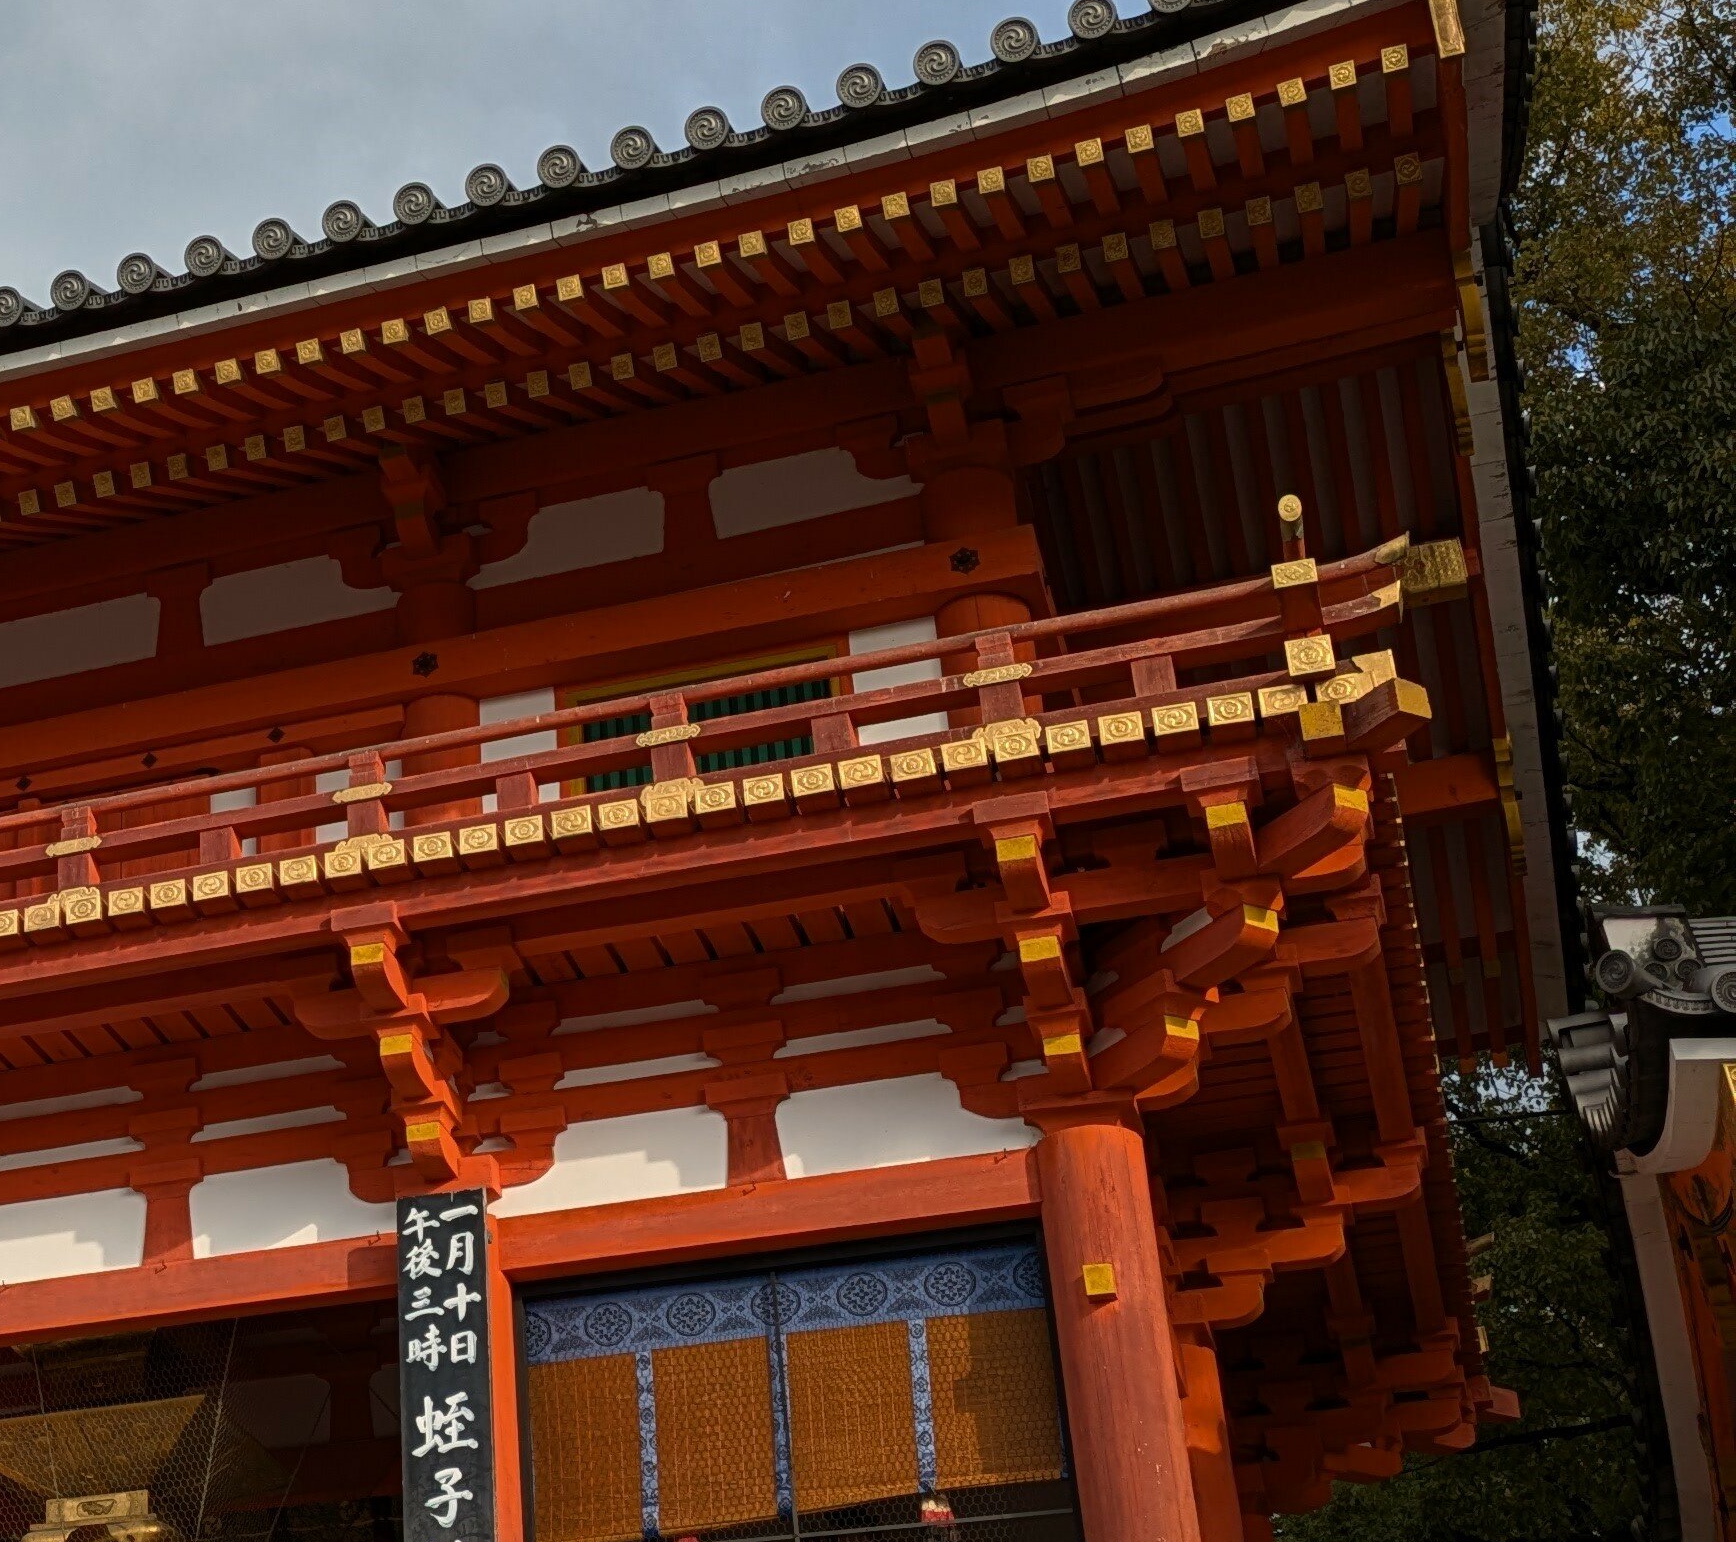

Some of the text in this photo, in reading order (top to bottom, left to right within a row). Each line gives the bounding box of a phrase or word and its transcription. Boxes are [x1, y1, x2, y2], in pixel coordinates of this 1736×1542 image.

[401, 1206, 447, 1371] 午後三時
[439, 1203, 482, 1364] 一月十日
